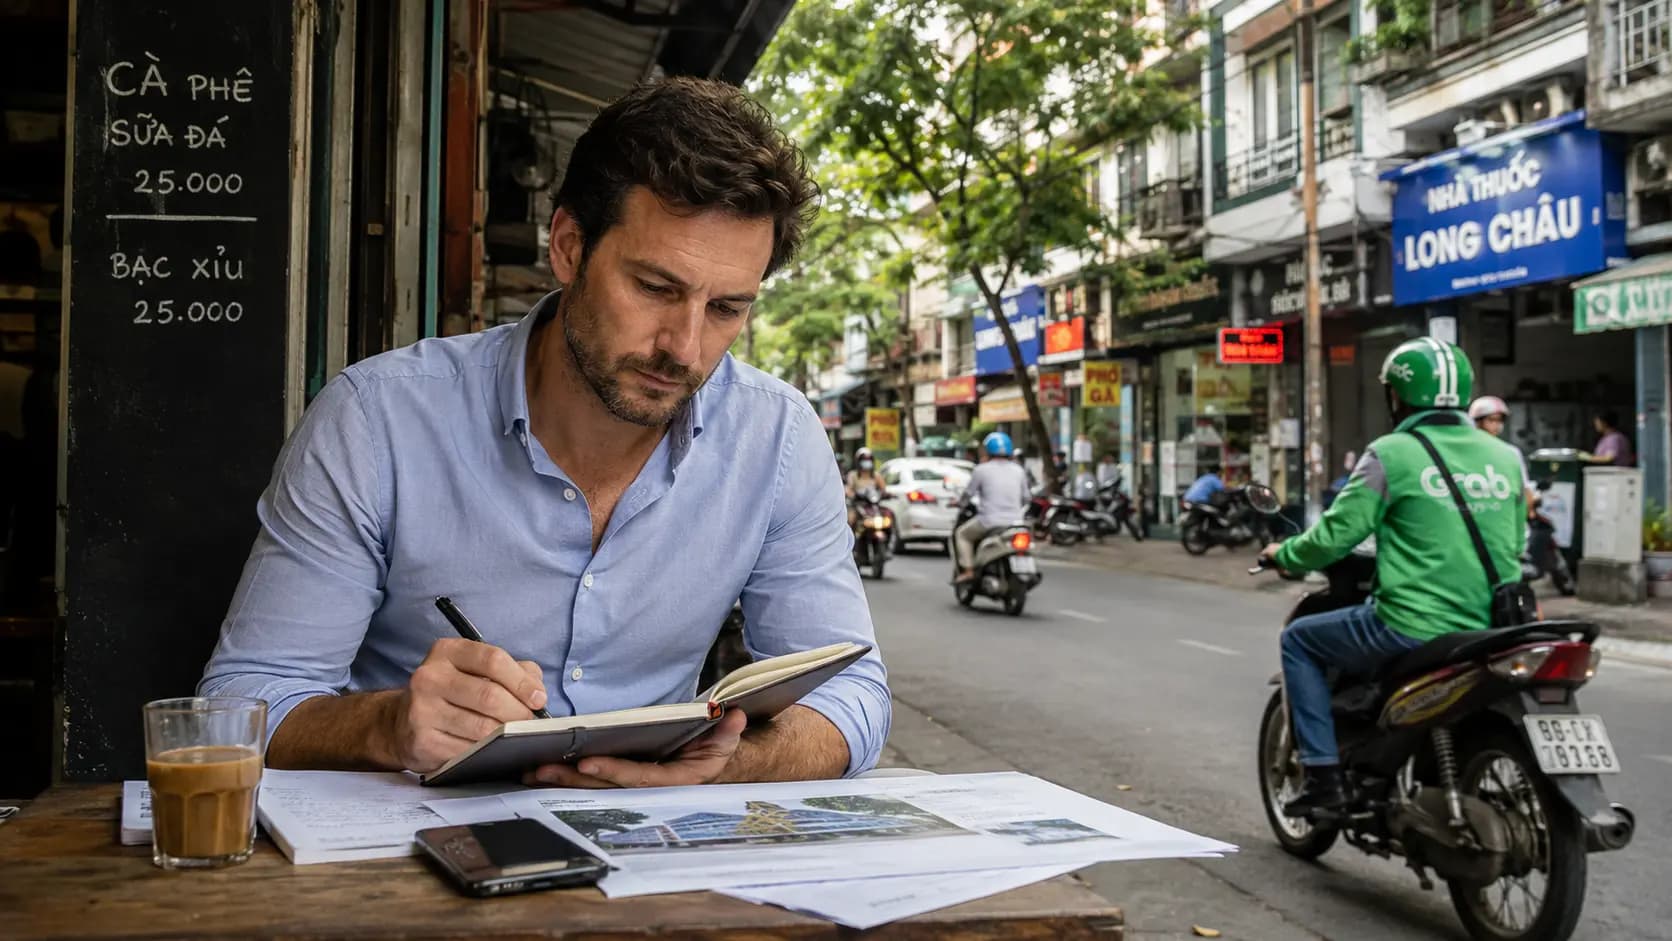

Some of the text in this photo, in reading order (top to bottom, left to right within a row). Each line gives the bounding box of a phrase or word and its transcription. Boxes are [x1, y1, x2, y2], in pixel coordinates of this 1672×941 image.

[106, 51, 253, 103] CÀ PHÊ
[110, 112, 229, 149] SỮA ĐÁ
[133, 169, 243, 195] 25.000
[1428, 150, 1542, 213] NHÀ THUỐC
[1405, 192, 1581, 271] LONG CHÂU
[110, 252, 171, 286] BẠC
[133, 299, 243, 325] 25.000
